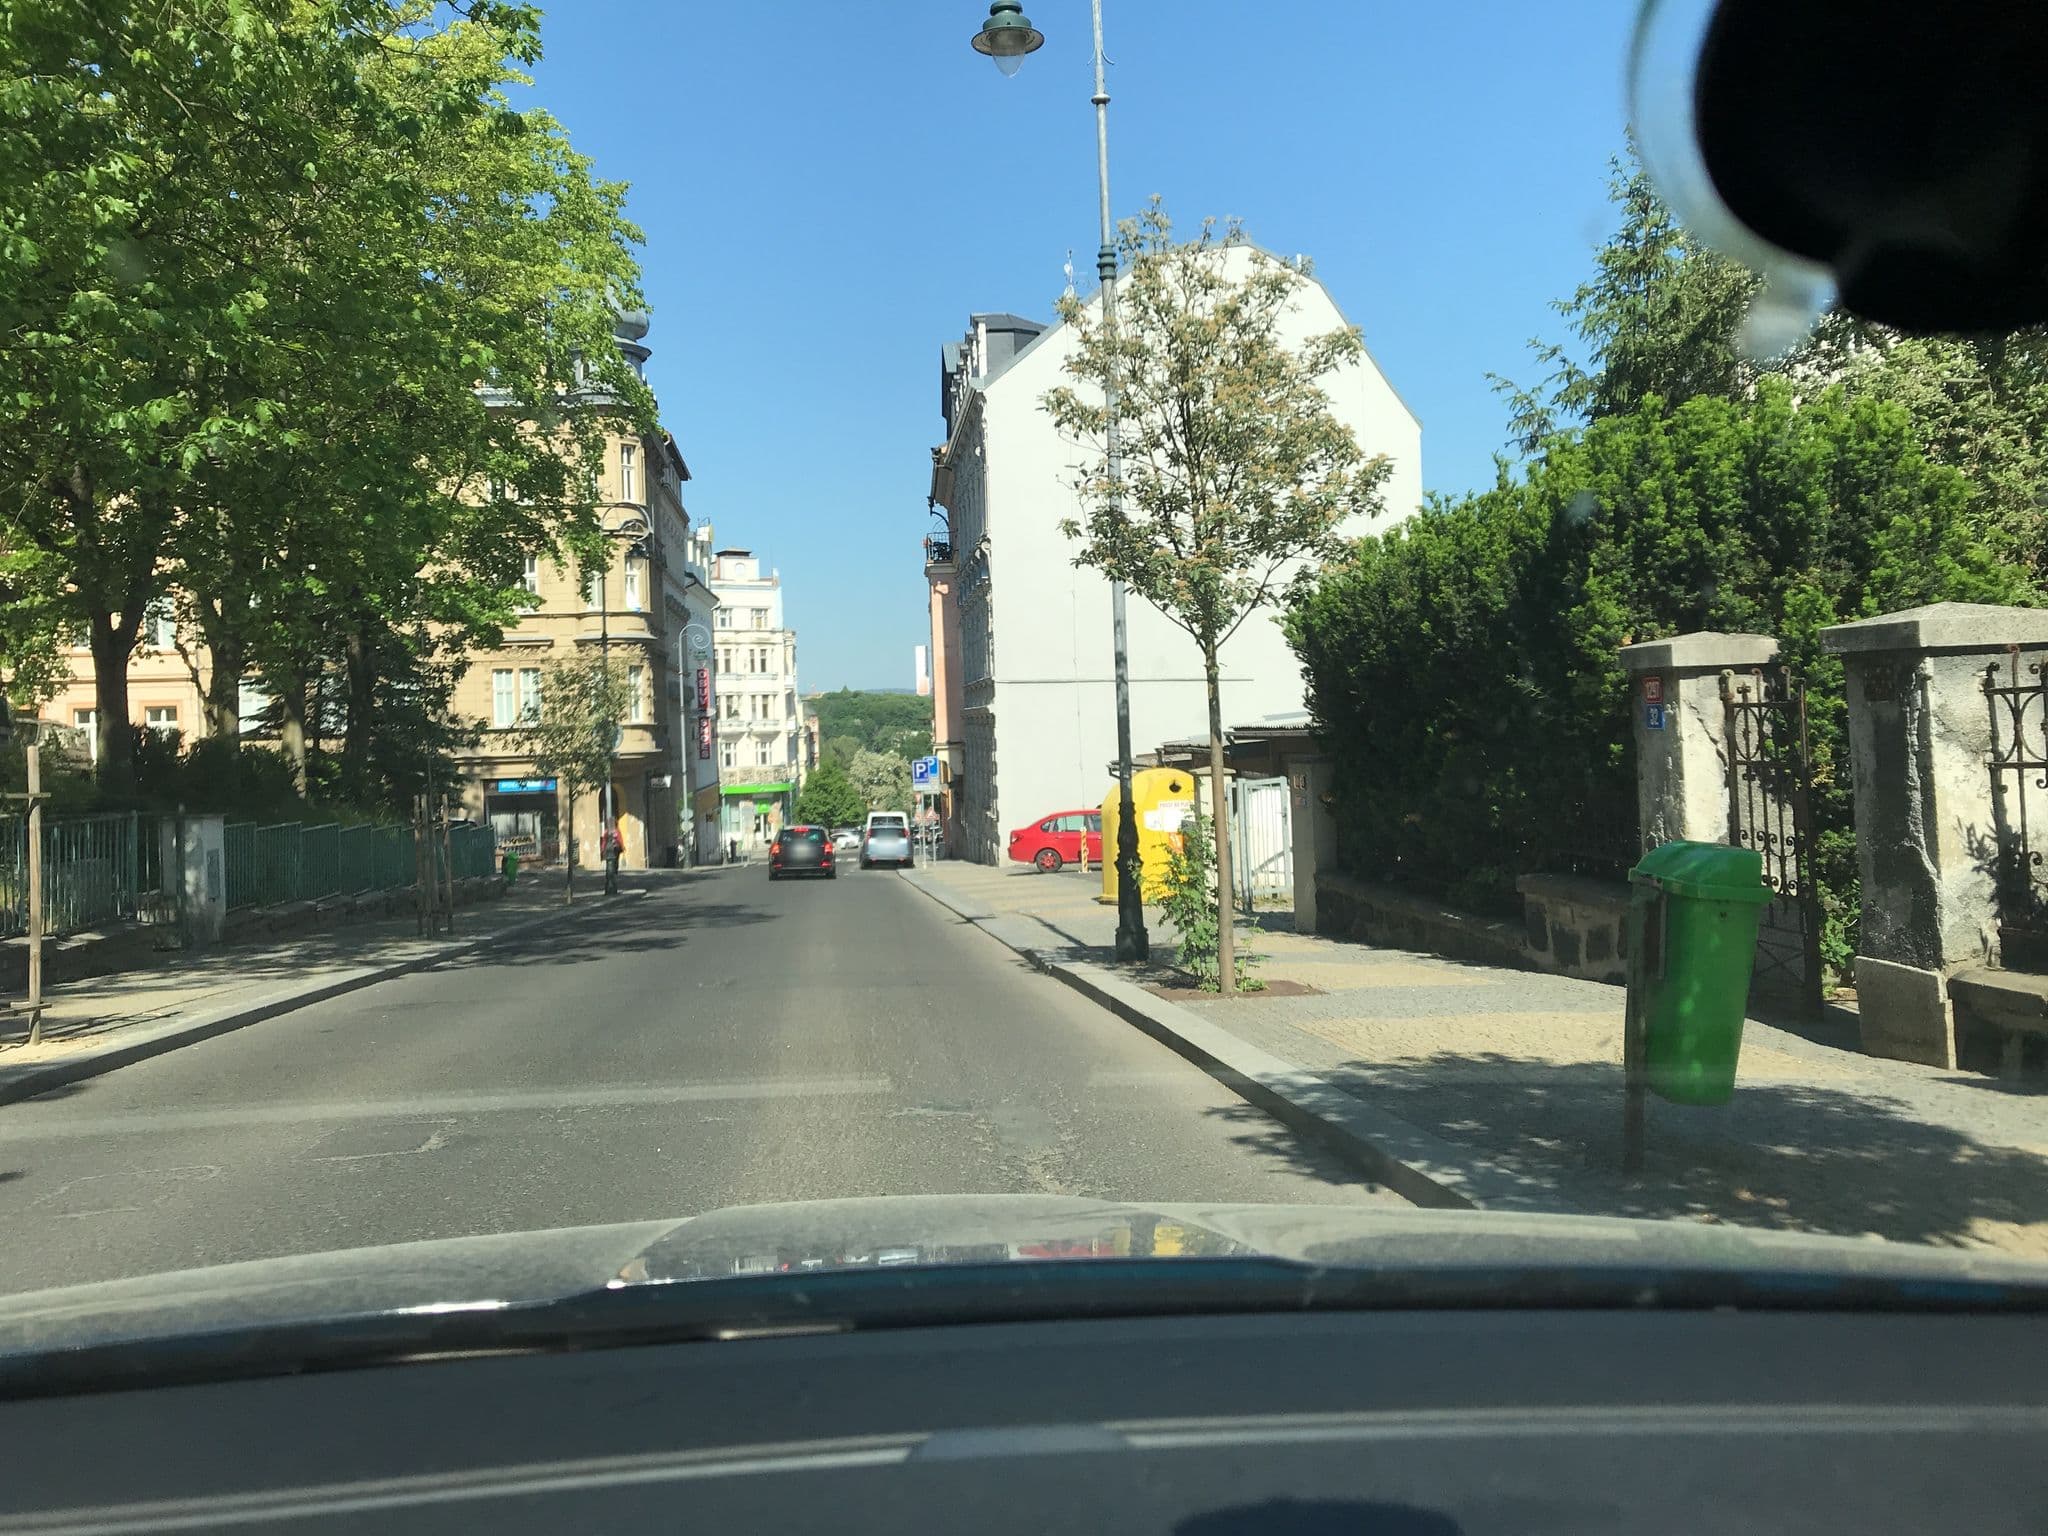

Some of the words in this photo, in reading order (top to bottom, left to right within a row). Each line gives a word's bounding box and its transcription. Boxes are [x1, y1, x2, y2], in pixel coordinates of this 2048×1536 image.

[698, 670, 708, 706] OBUV
[700, 718, 710, 758] SHOES
[916, 763, 926, 778] P
